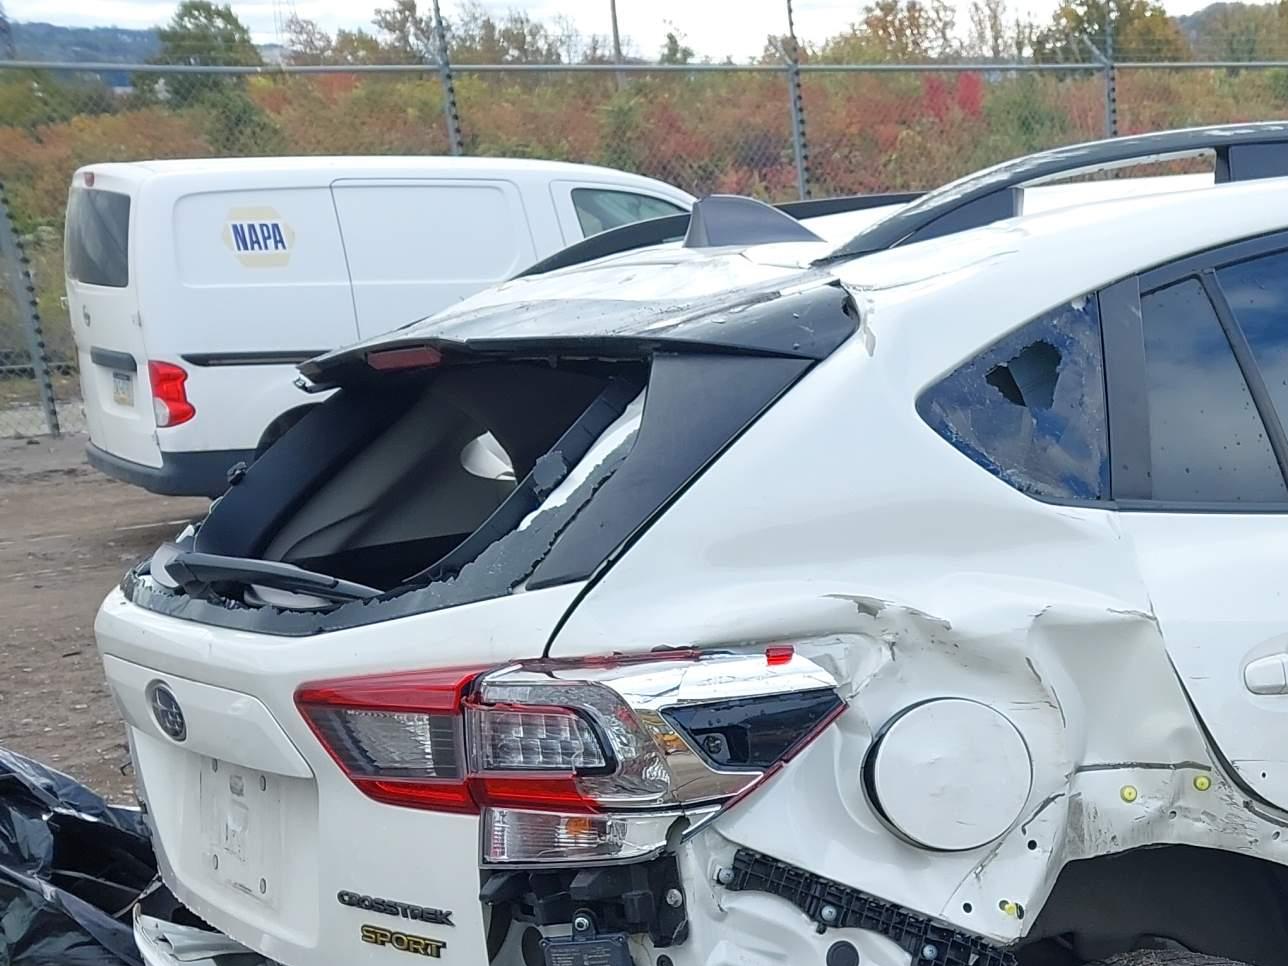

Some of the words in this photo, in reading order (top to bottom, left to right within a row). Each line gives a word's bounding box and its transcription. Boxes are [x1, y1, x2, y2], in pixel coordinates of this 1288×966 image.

[231, 223, 288, 251] NAPA
[337, 890, 456, 927] CROSSTREK
[361, 924, 447, 958] SPORT
